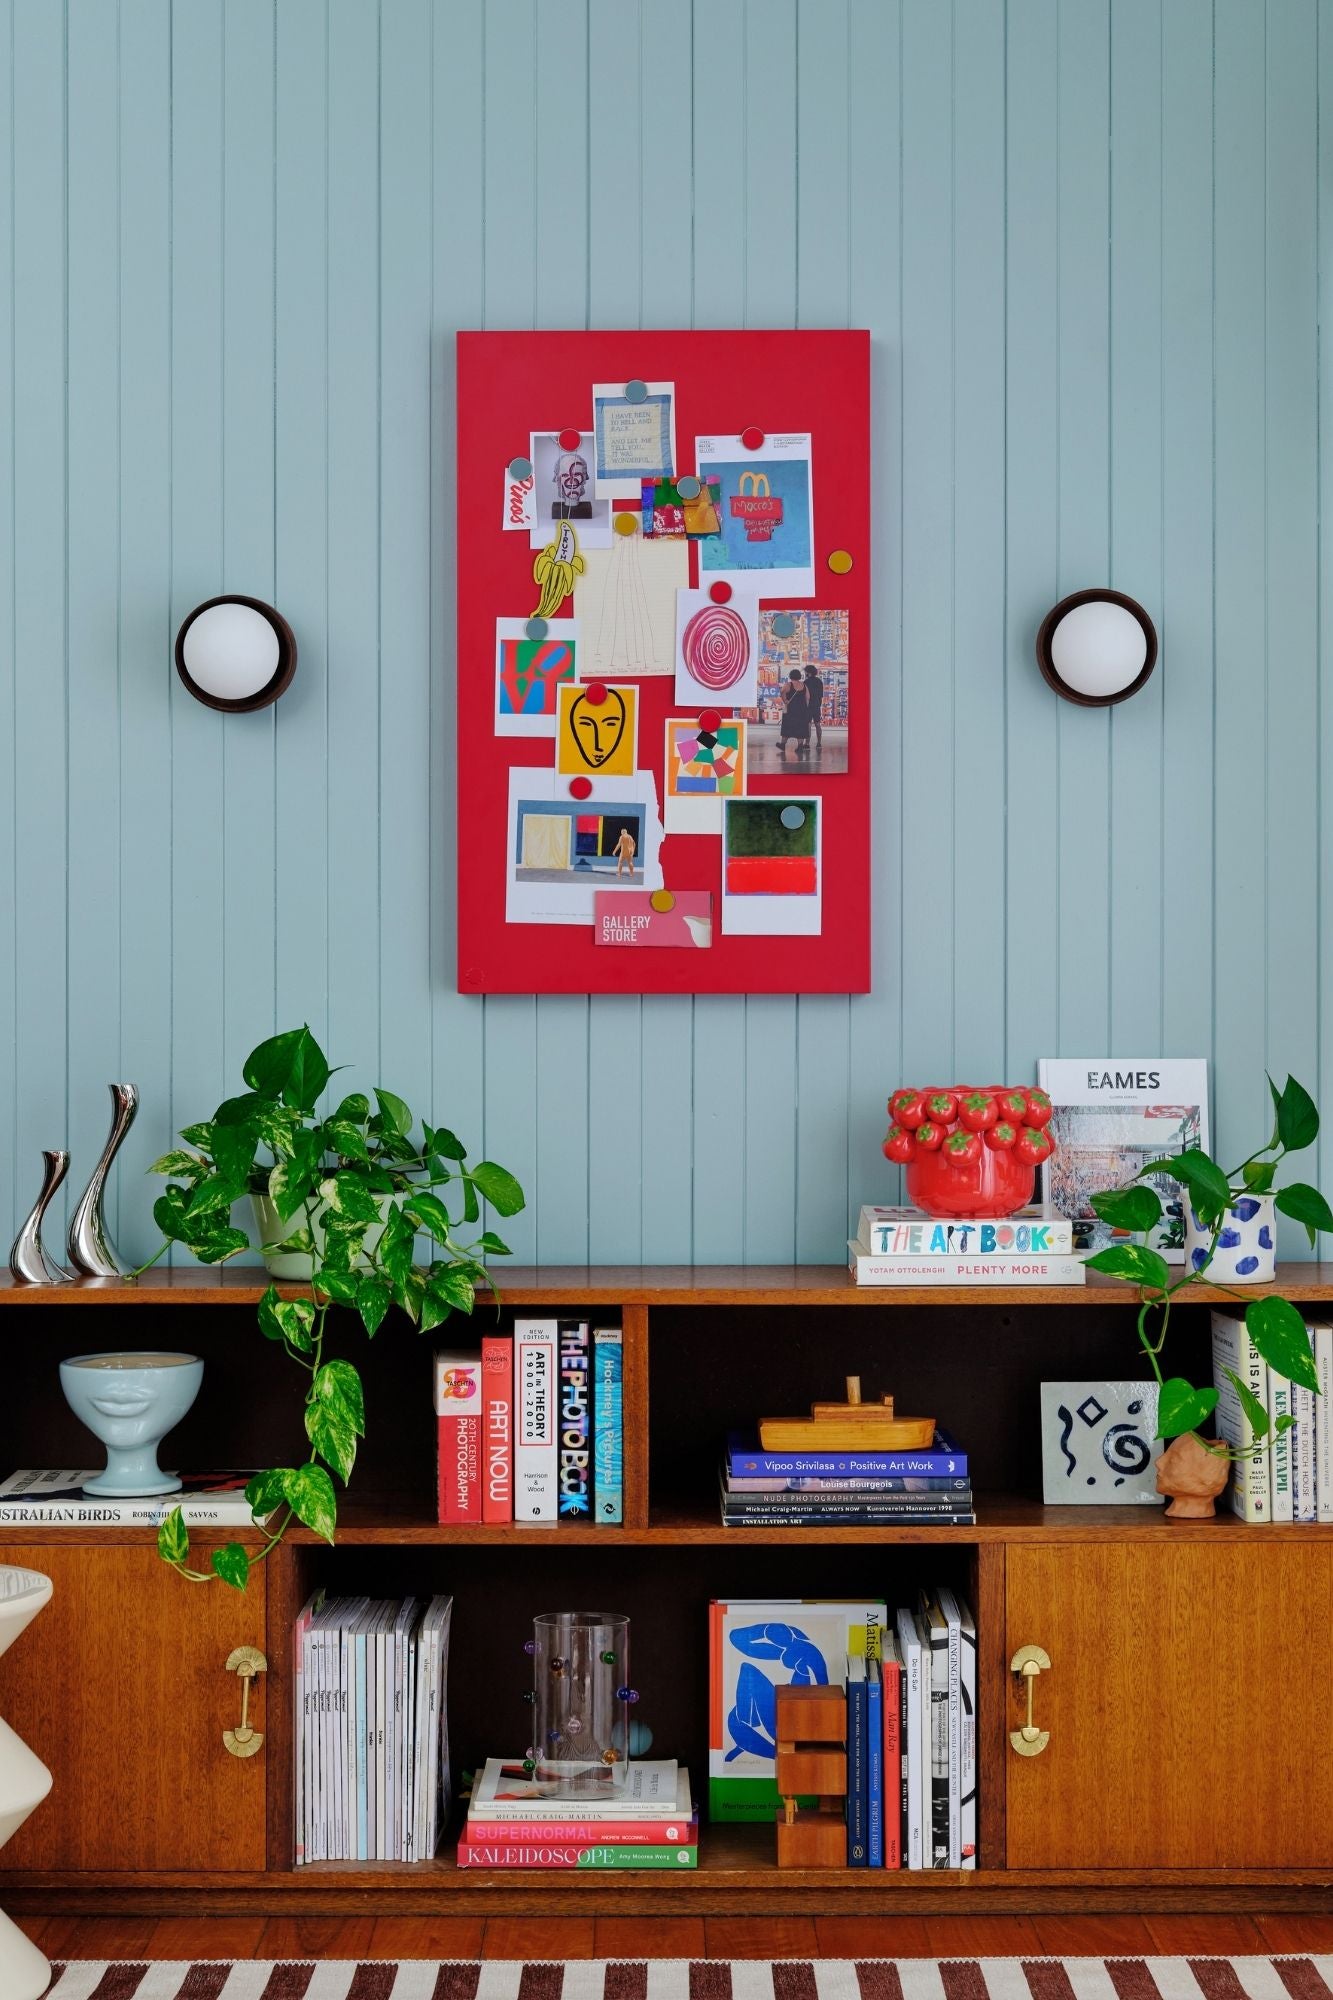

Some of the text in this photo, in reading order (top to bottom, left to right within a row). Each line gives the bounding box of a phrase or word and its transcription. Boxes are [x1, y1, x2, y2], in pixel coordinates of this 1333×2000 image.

[560, 529, 570, 560] TRUTH
[603, 916, 651, 929] GALLERY
[603, 929, 637, 942] STORE
[1087, 1072, 1160, 1089] EAMES
[874, 1225, 924, 1253] THE
[929, 1224, 976, 1254] ART
[957, 1265, 1048, 1275] PLENTY MORE
[535, 1352, 545, 1376] ART
[1250, 1365, 1259, 1376] IS
[535, 1389, 545, 1439] THEORY
[601, 1360, 615, 1485] Hockney's Pictures
[490, 1401, 508, 1501] ART NOW
[457, 1418, 468, 1510] PHOTOGRAPHY
[469, 1444, 477, 1483] CENTURY
[764, 1461, 835, 1472] Vipoo Srivilasa
[850, 1461, 934, 1470] Positive Art Work
[820, 1480, 893, 1490] Louise Bourgeois
[0, 1509, 121, 1521] STRALIAN BIRDS
[866, 1612, 879, 1660] Matiss
[950, 1628, 958, 1676] CHANGING
[912, 1659, 918, 1668] Do
[912, 1668, 917, 1678] Ho
[950, 1678, 958, 1711] PLACES
[888, 1712, 897, 1733] Man
[888, 1736, 897, 1753] Ray
[475, 1826, 597, 1840] SUPERNORMAL
[871, 1800, 879, 1859] EARTH PILGRIM
[468, 1848, 615, 1864] KALEIDOSCOPE
